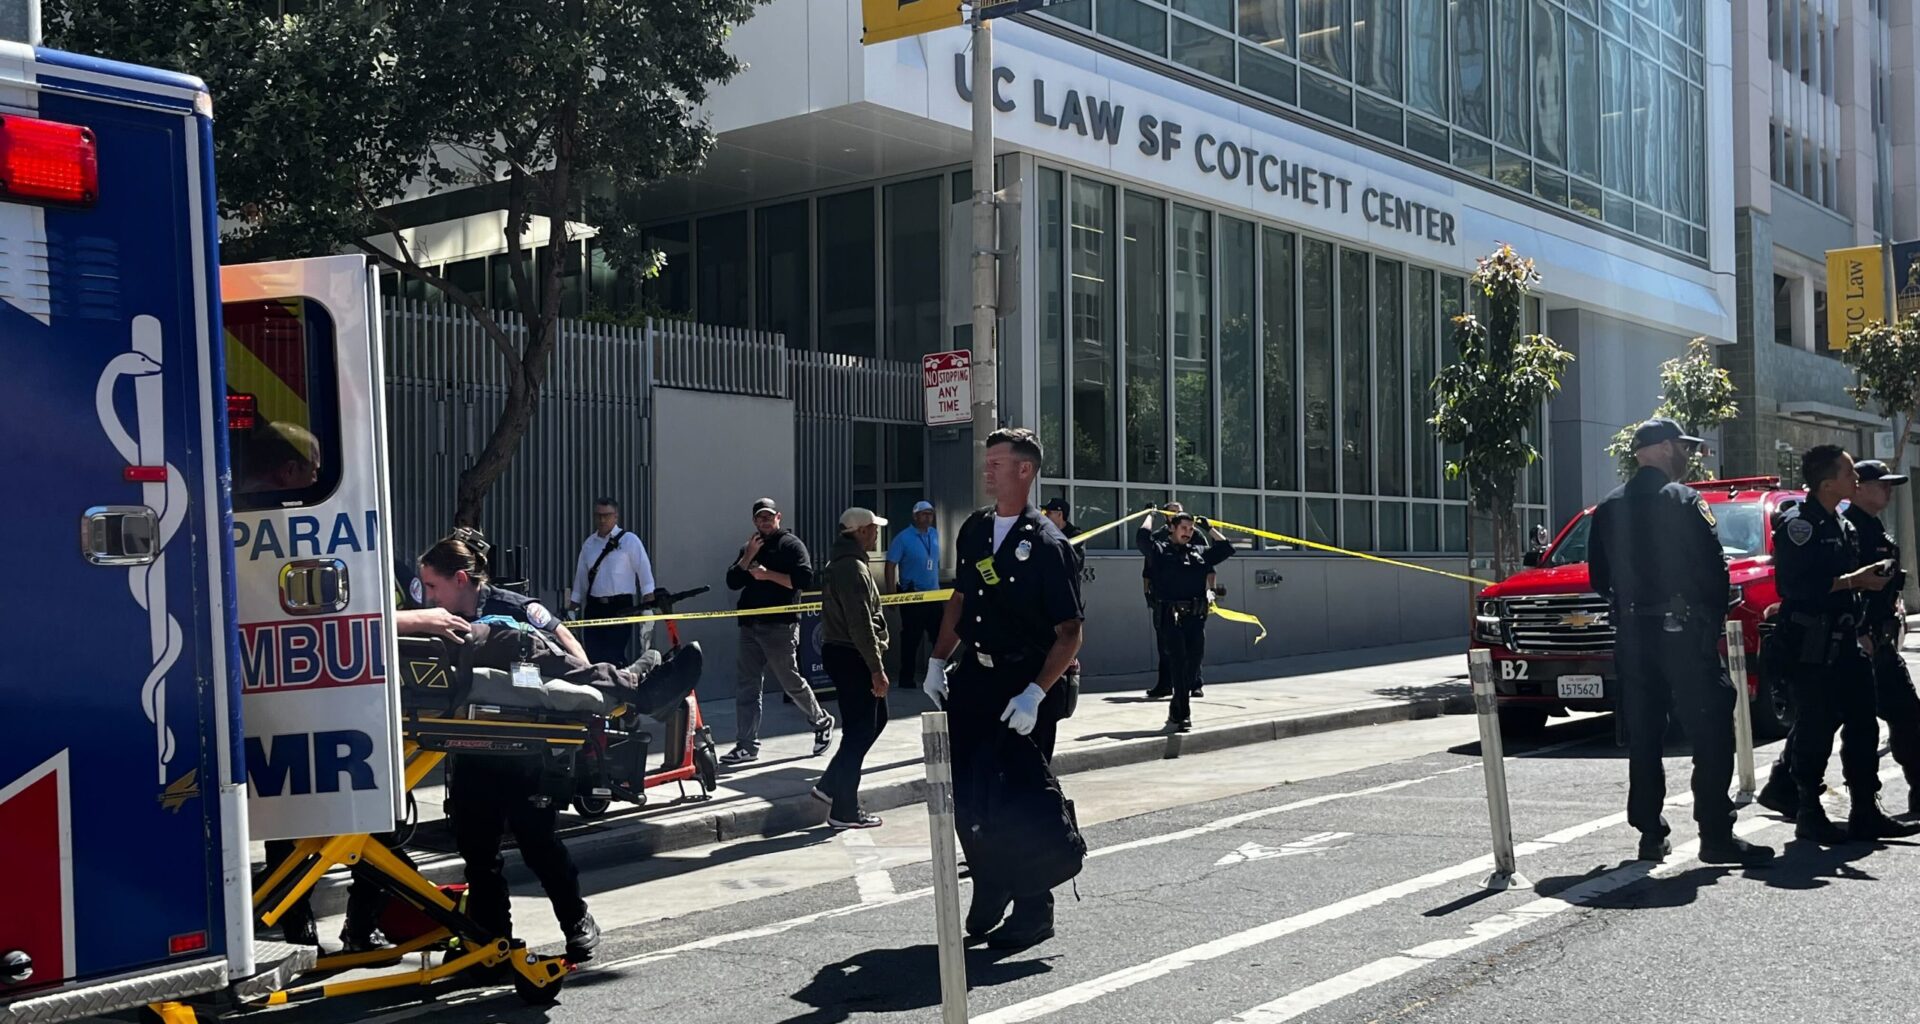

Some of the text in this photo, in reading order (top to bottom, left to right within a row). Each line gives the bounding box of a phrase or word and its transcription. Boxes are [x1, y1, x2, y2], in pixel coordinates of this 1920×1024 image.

[1033, 78, 1125, 145] LAW
[1138, 114, 1182, 161] SF
[1194, 133, 1352, 214] COTCHETT
[1361, 187, 1456, 246] CENTER
[1845, 260, 1865, 342] UC Law
[925, 369, 968, 386] NO STOPPING
[938, 385, 958, 399] ANY
[938, 400, 959, 413] TIME
[1500, 659, 1529, 680] B2
[1561, 683, 1600, 697] 1575627
